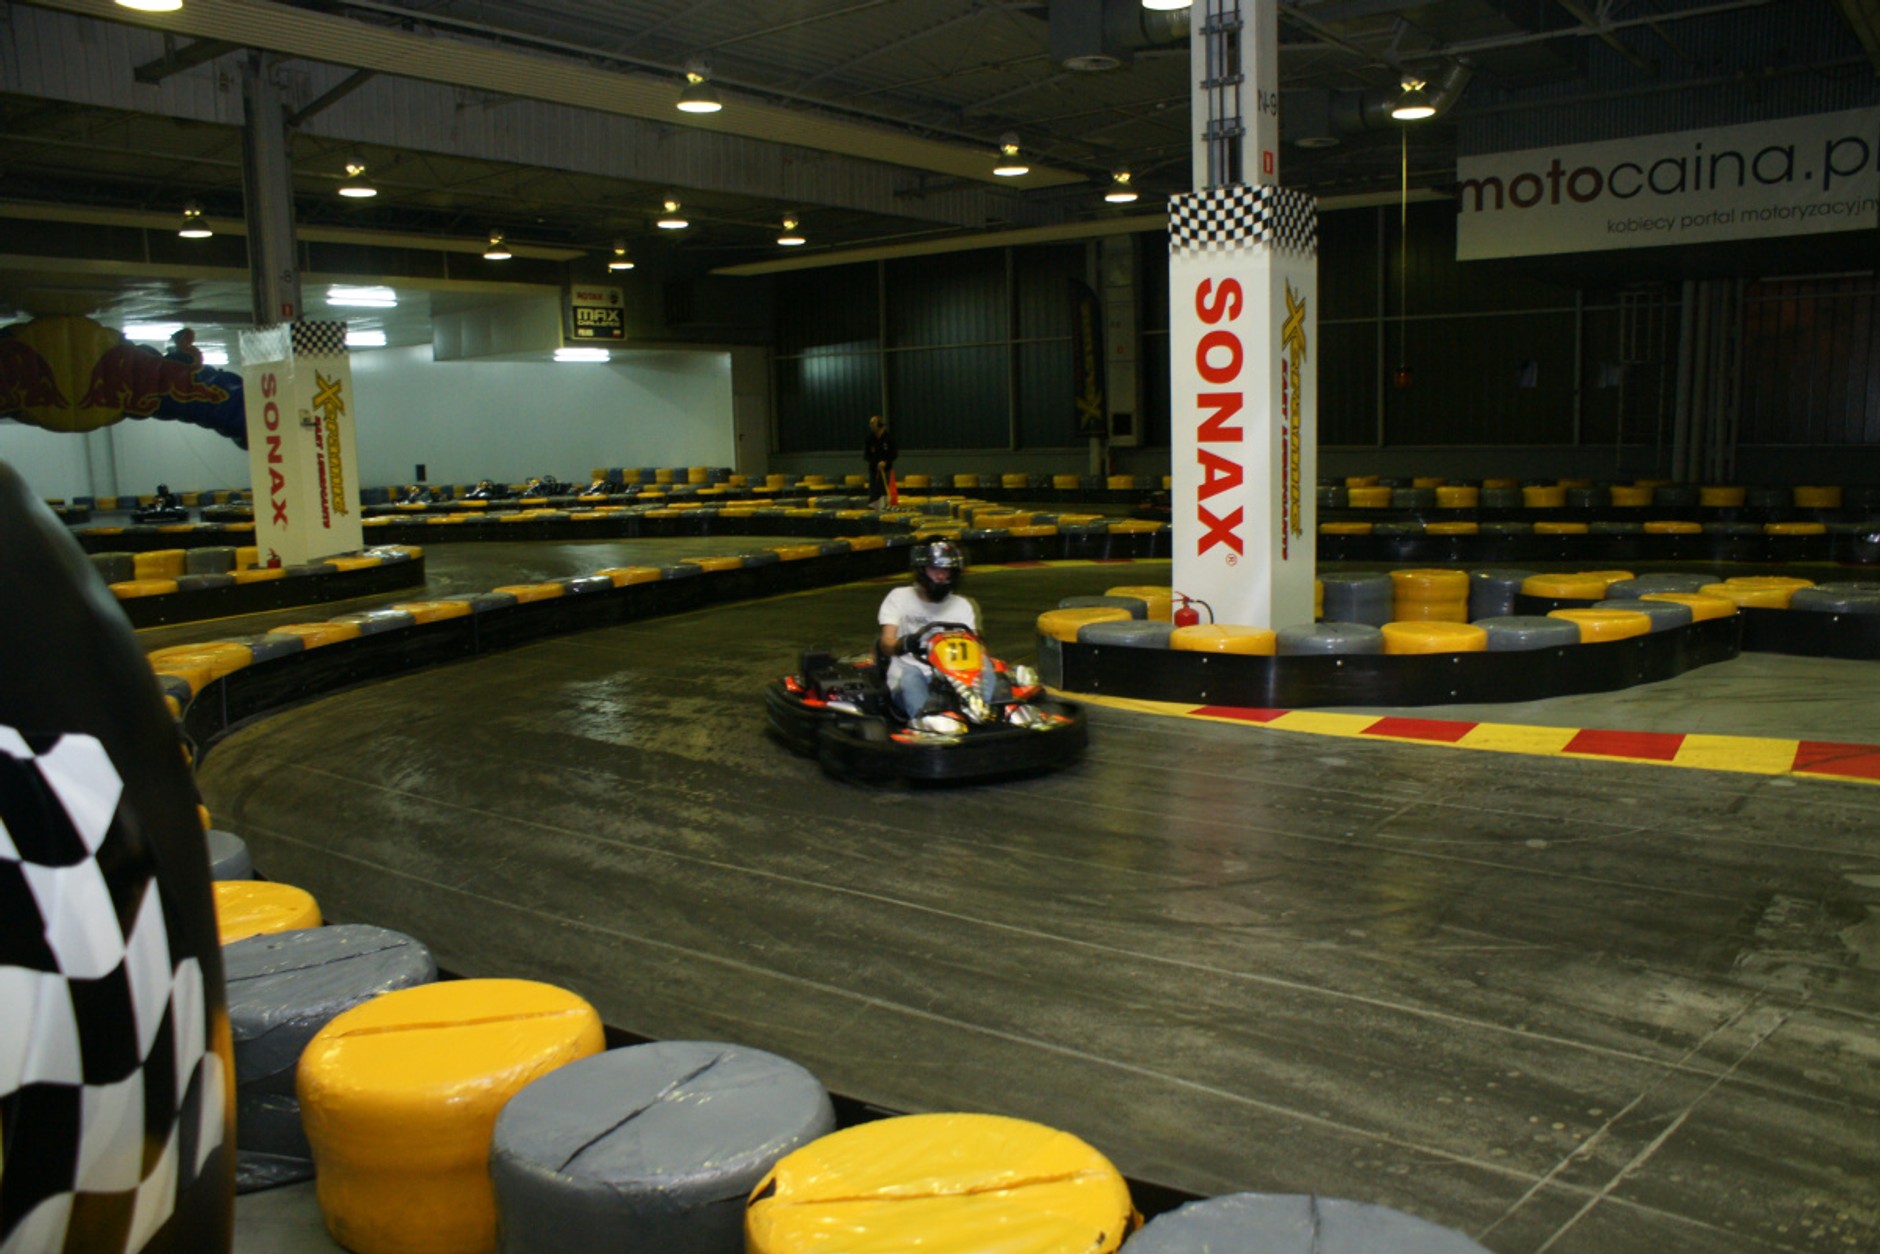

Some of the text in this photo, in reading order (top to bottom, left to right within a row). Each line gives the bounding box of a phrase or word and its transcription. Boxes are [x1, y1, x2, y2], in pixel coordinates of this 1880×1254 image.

[1607, 216, 1675, 234] kobiecy
[1681, 209, 1735, 231] portal
[261, 372, 288, 526] SONAX
[1196, 277, 1244, 556] SONAX
